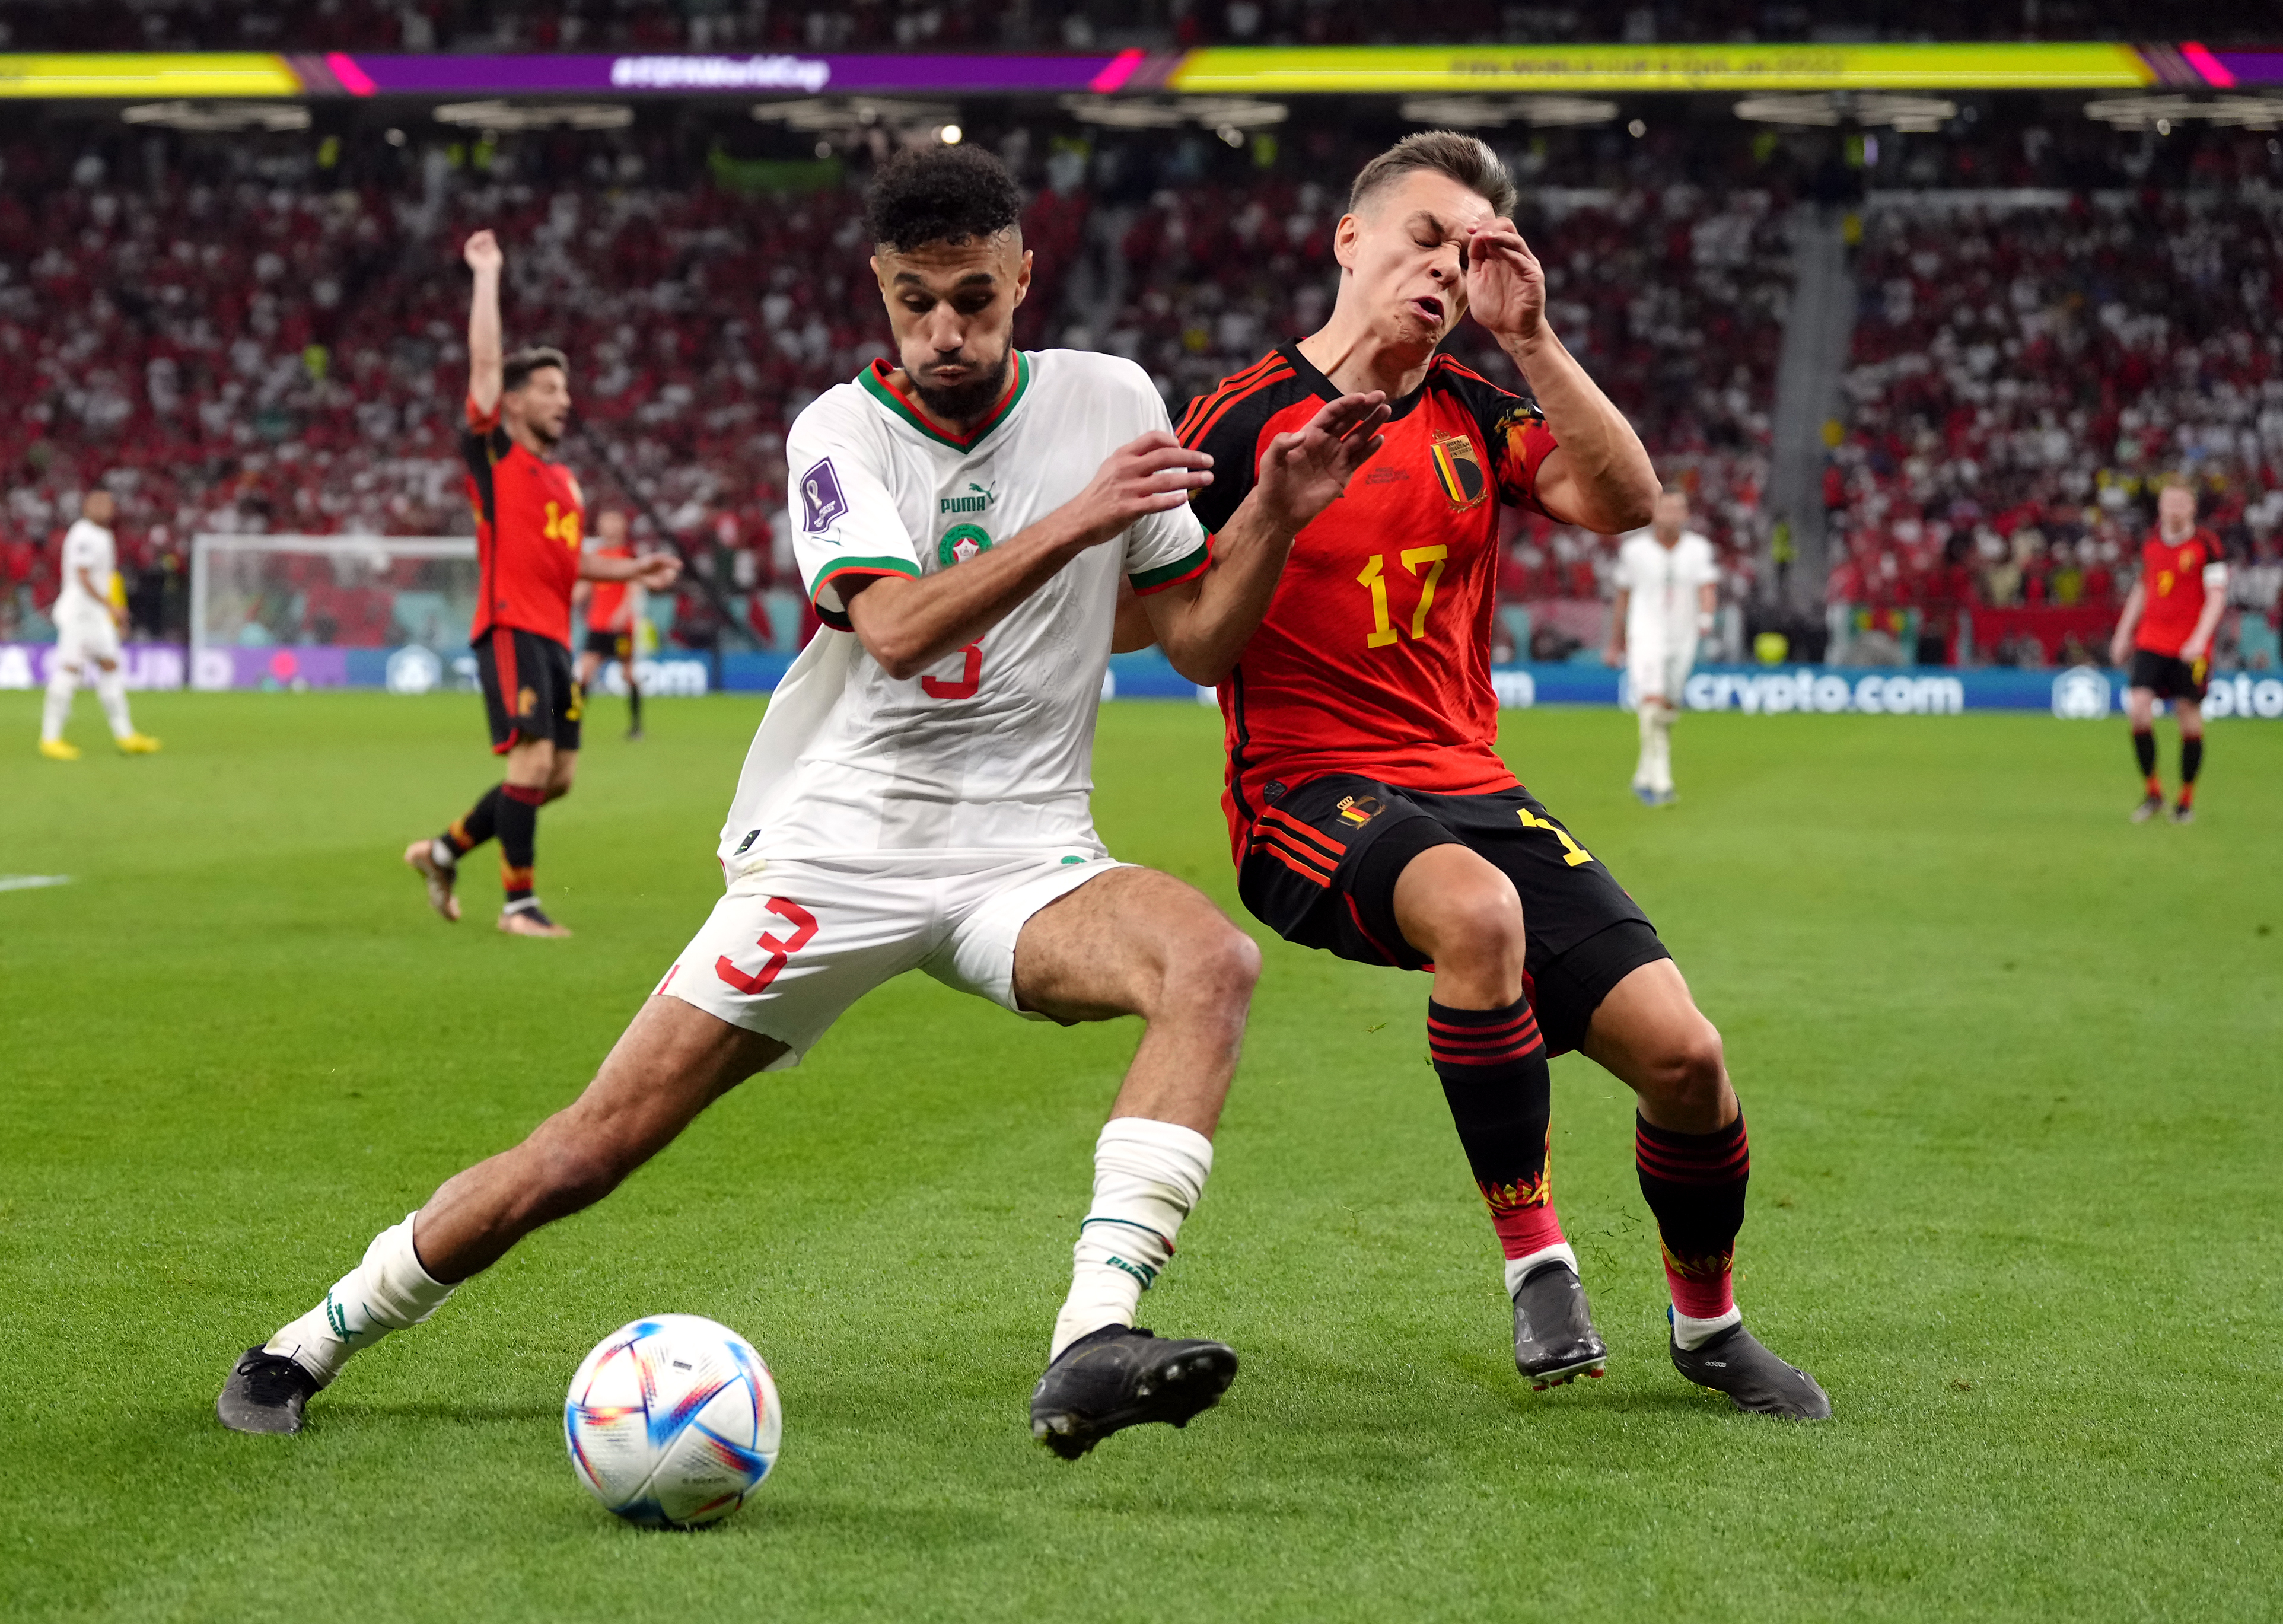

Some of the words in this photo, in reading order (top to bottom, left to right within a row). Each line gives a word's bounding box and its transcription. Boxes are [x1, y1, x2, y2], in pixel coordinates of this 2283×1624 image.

[544, 501, 579, 550] 14
[941, 496, 985, 514] PUMA
[1356, 544, 1448, 648] 17
[1683, 668, 1964, 716] crypto.com
[715, 897, 819, 995] 3
